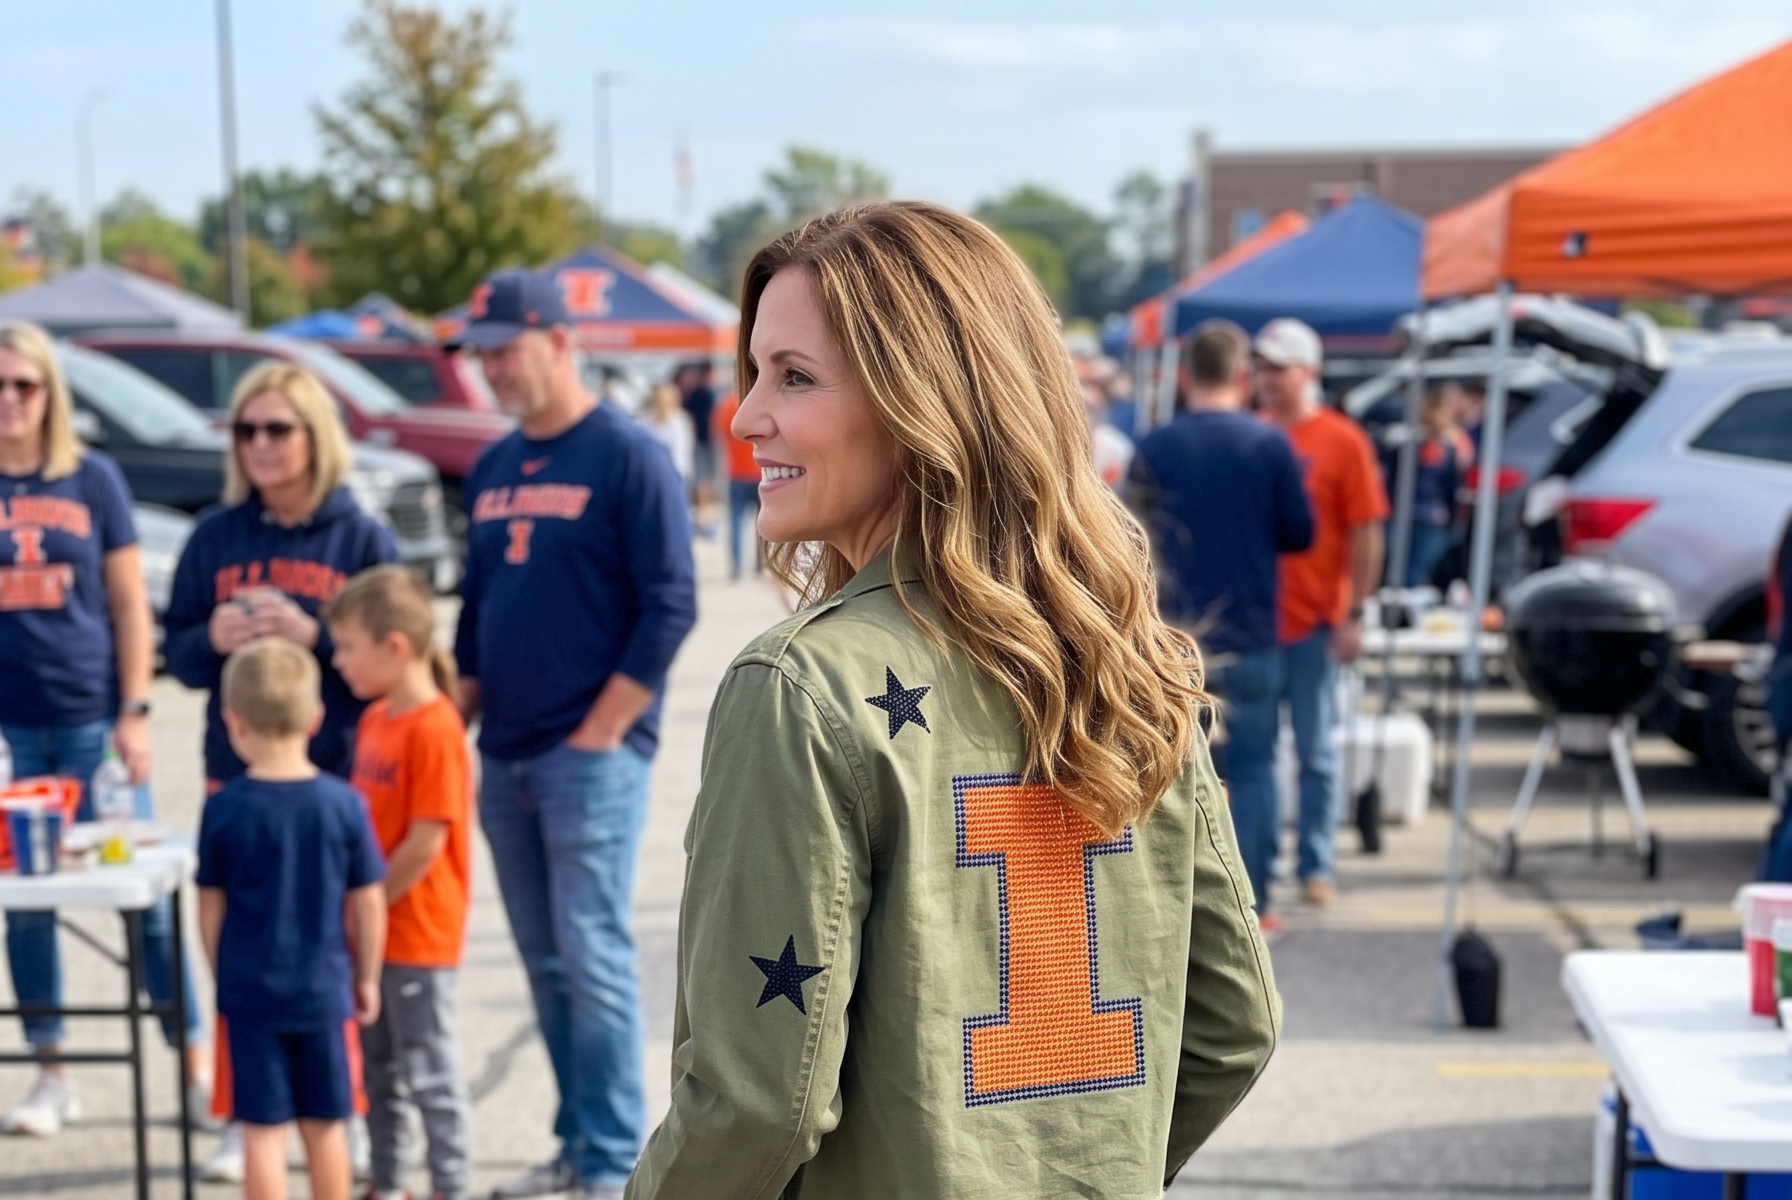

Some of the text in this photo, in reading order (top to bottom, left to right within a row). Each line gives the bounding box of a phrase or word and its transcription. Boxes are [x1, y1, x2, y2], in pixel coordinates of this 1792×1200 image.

[472, 483, 593, 524] ILLINOIS
[10, 526, 47, 566] I
[505, 518, 535, 565] I
[952, 771, 1145, 1108] I
